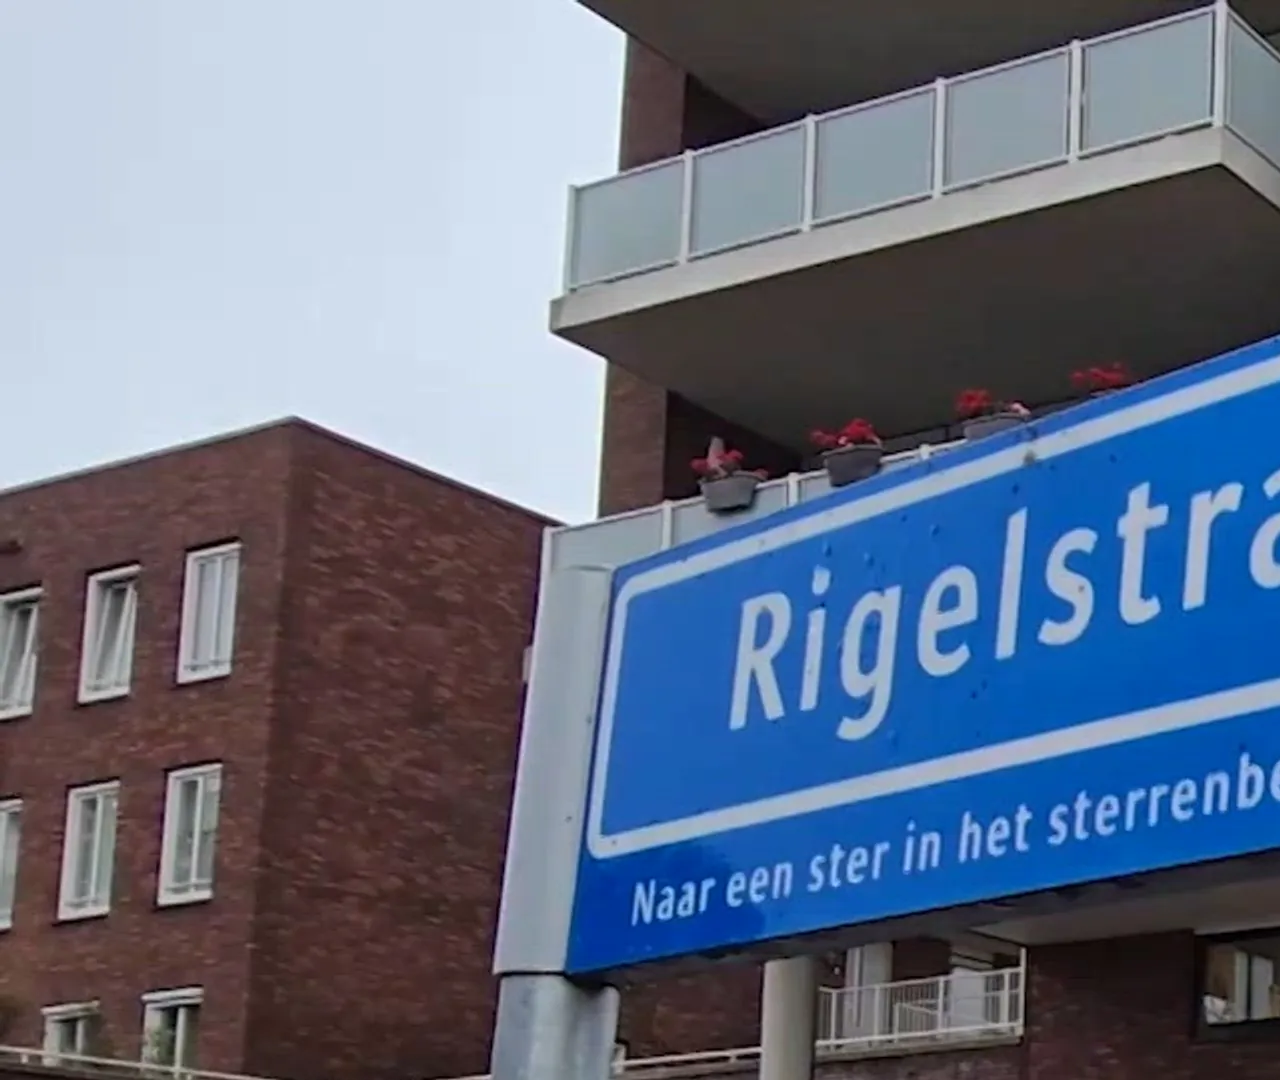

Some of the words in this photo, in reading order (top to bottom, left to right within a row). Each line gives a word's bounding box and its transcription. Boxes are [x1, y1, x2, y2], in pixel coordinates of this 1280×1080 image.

[631, 877, 716, 926] Naar
[726, 861, 793, 908] een
[807, 840, 890, 893] ster
[903, 820, 940, 873] in
[958, 803, 1033, 863] het
